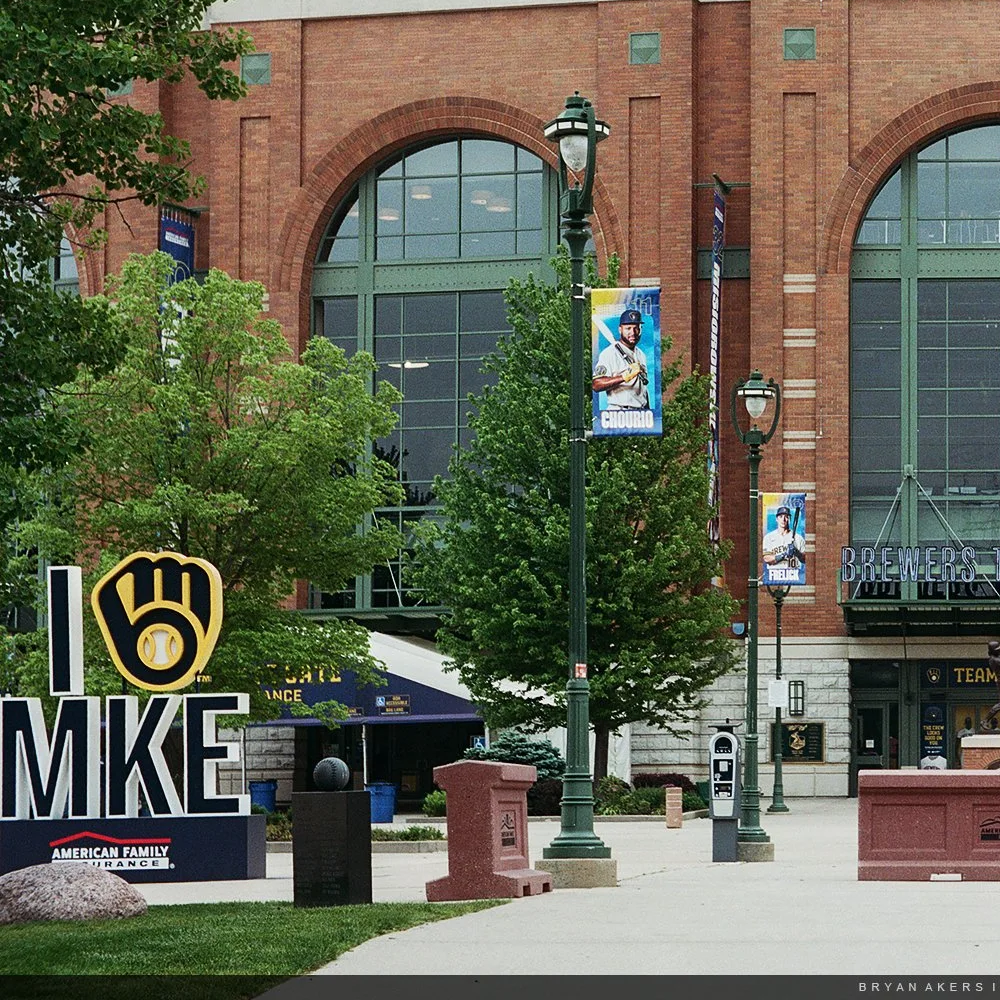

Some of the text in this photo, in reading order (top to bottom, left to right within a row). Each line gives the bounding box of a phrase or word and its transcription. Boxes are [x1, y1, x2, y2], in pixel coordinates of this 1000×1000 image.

[601, 410, 654, 428] CHOURIO
[841, 546, 976, 583] BREWERS
[768, 569, 799, 581] FRELICK
[47, 566, 84, 696] I
[953, 667, 998, 683] TEAM
[1, 694, 250, 818] MKE
[52, 846, 169, 859] AMERICAN FAMILY
